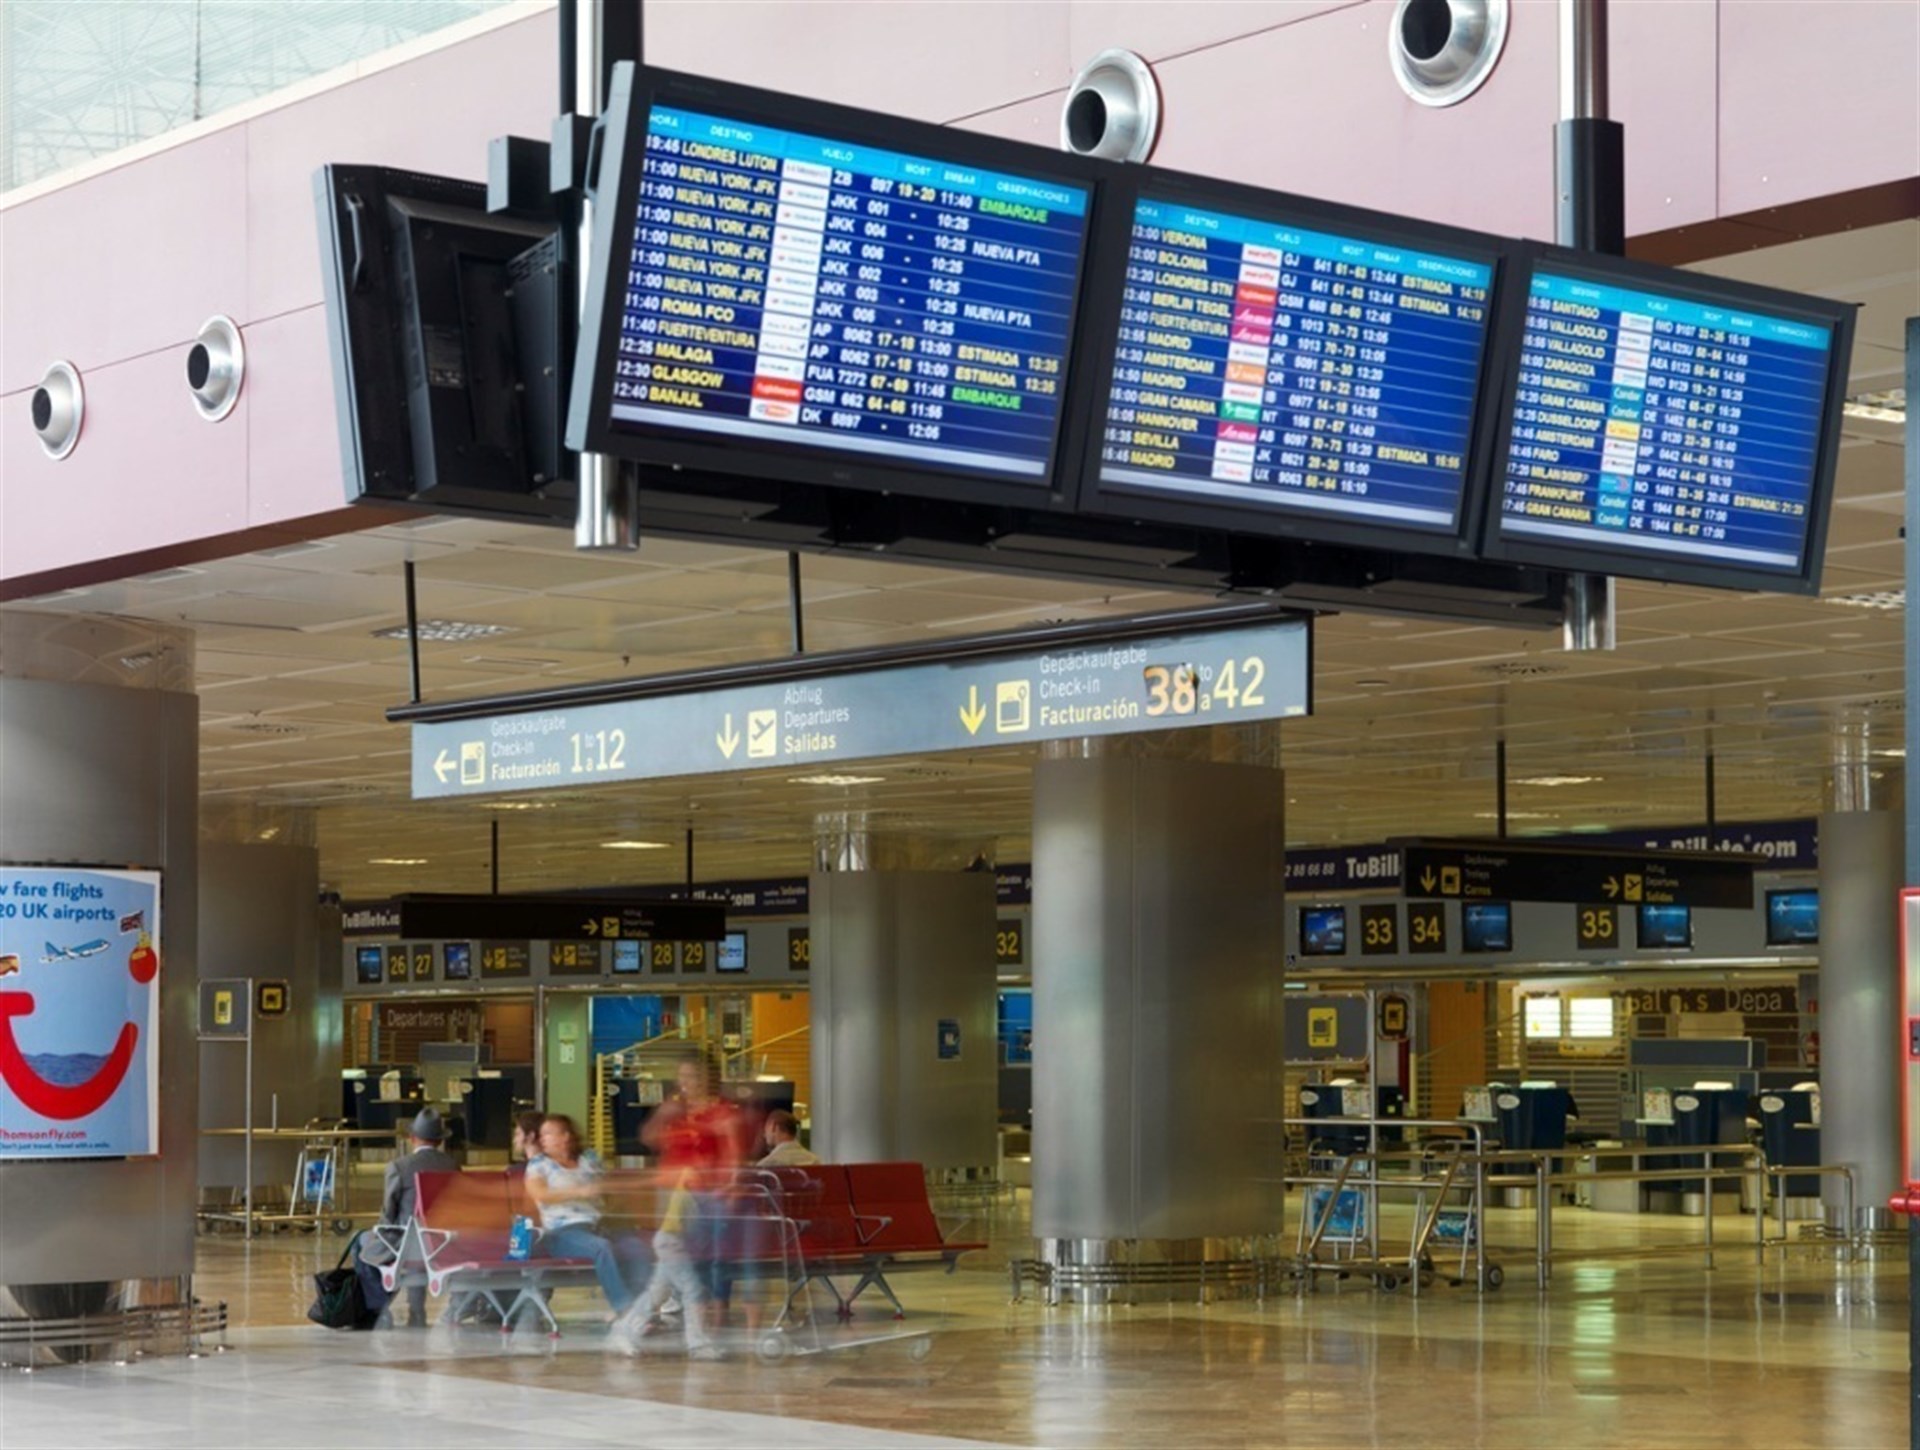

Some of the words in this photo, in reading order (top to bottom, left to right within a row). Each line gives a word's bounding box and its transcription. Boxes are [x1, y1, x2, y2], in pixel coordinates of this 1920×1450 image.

[710, 125, 752, 142] DESTINO
[643, 158, 678, 178] 11:00
[678, 165, 719, 185] NUEVA
[720, 172, 752, 190] YORK
[753, 179, 776, 195] JFK
[830, 194, 858, 211] JKK
[682, 142, 736, 164] LONDRES
[833, 169, 853, 186] ZB
[941, 191, 973, 209] 11:40
[979, 198, 1047, 222] EMBARQUE
[637, 204, 672, 223] 11:00
[672, 211, 712, 230] NUEVA
[715, 218, 746, 236] YORK
[747, 224, 770, 240] JFK
[824, 238, 852, 255] JKK
[640, 181, 675, 200] 11:00
[675, 188, 716, 207] NUEVA
[718, 195, 749, 213] YORK
[750, 201, 773, 217] JFK
[827, 215, 855, 232] JKK
[972, 241, 1015, 261] NUEVA
[1016, 249, 1040, 265] PTA
[634, 227, 669, 245] 11:00
[669, 233, 709, 252] NUEVA
[711, 240, 743, 257] YORK
[743, 246, 767, 262] JFK
[822, 259, 849, 276] JKK
[1161, 231, 1207, 249] VERONA
[1402, 275, 1452, 294] ESTIMADA
[631, 248, 666, 267] 11:00
[667, 254, 707, 273] NUEVA
[709, 261, 740, 278] YORK
[741, 267, 764, 283] JFK
[819, 280, 846, 296] JKK
[964, 304, 1006, 323] NUEVA
[1007, 311, 1031, 327] PTA
[1155, 272, 1209, 293] LONDRES
[1158, 250, 1208, 271] BOLONIA
[1399, 294, 1450, 315] ESTIMADA
[628, 270, 663, 289] 11:00
[663, 276, 704, 295] NUEVA
[705, 283, 737, 300] YORK
[738, 288, 761, 304] JFK
[816, 301, 843, 318] JKK
[1152, 292, 1194, 311] BERLIN
[1196, 299, 1232, 318] TEGEL
[1552, 301, 1600, 319] SANTIAGO
[625, 292, 660, 311] 11:40
[661, 297, 703, 317] ROMA
[705, 304, 735, 322] FCO
[812, 322, 833, 337] AP
[920, 339, 952, 357] 13:00
[957, 345, 1019, 367] ESTIMADA
[1149, 311, 1228, 336] FUERTEVENTURA
[1549, 320, 1608, 341] VALLADOLID
[622, 315, 658, 333] 11:40
[657, 320, 755, 348] FUERTEVENTURA
[809, 343, 830, 359] AP
[917, 360, 949, 378] 13:00
[954, 366, 1016, 387] ESTIMADA
[1147, 331, 1192, 350] MADRID
[1547, 339, 1606, 359] VALLADOLID
[1143, 351, 1215, 373] AMSTERDAM
[1544, 357, 1595, 376] ZARAGOZA
[651, 364, 724, 388] GLASGOW
[655, 342, 713, 364] MALAGA
[952, 387, 1020, 409] EMBARQUE
[1141, 371, 1186, 390] MADRID
[614, 382, 648, 399] 12:40
[649, 386, 703, 407] BANJUL
[801, 407, 822, 423] DK
[1138, 391, 1169, 407] GRAN
[1170, 396, 1216, 414] CANARIA
[1133, 431, 1179, 449] SEVILLA
[1136, 412, 1198, 431] HANNOVER
[1377, 446, 1428, 464] ESTIMADA
[1130, 451, 1175, 469] MADRID
[1528, 484, 1585, 501] FRANKFURT
[784, 686, 822, 704] Abflug
[1039, 677, 1099, 699] Check-in
[1144, 664, 1196, 716] 38
[1213, 655, 1265, 709] 42
[1040, 698, 1138, 726] Facturación
[1201, 692, 1211, 711] a
[784, 707, 850, 730] Departures
[491, 740, 535, 758] Check-in
[571, 732, 583, 773] 1
[596, 728, 625, 771] 12
[784, 732, 836, 754] Salidas
[492, 758, 560, 780] Facturación
[586, 757, 593, 771] a
[13, 881, 48, 897] fare
[52, 881, 103, 901] flights
[22, 903, 48, 919] UK
[52, 904, 116, 923] airports
[1582, 910, 1612, 938] 35
[1366, 918, 1393, 945] 33
[1413, 916, 1441, 943] 34
[654, 943, 673, 965] 28
[685, 943, 703, 965] 29
[791, 939, 809, 961] 30
[997, 931, 1018, 955] 32
[390, 955, 407, 975] 26
[415, 954, 432, 974] 27
[387, 1008, 444, 1028] Departures
